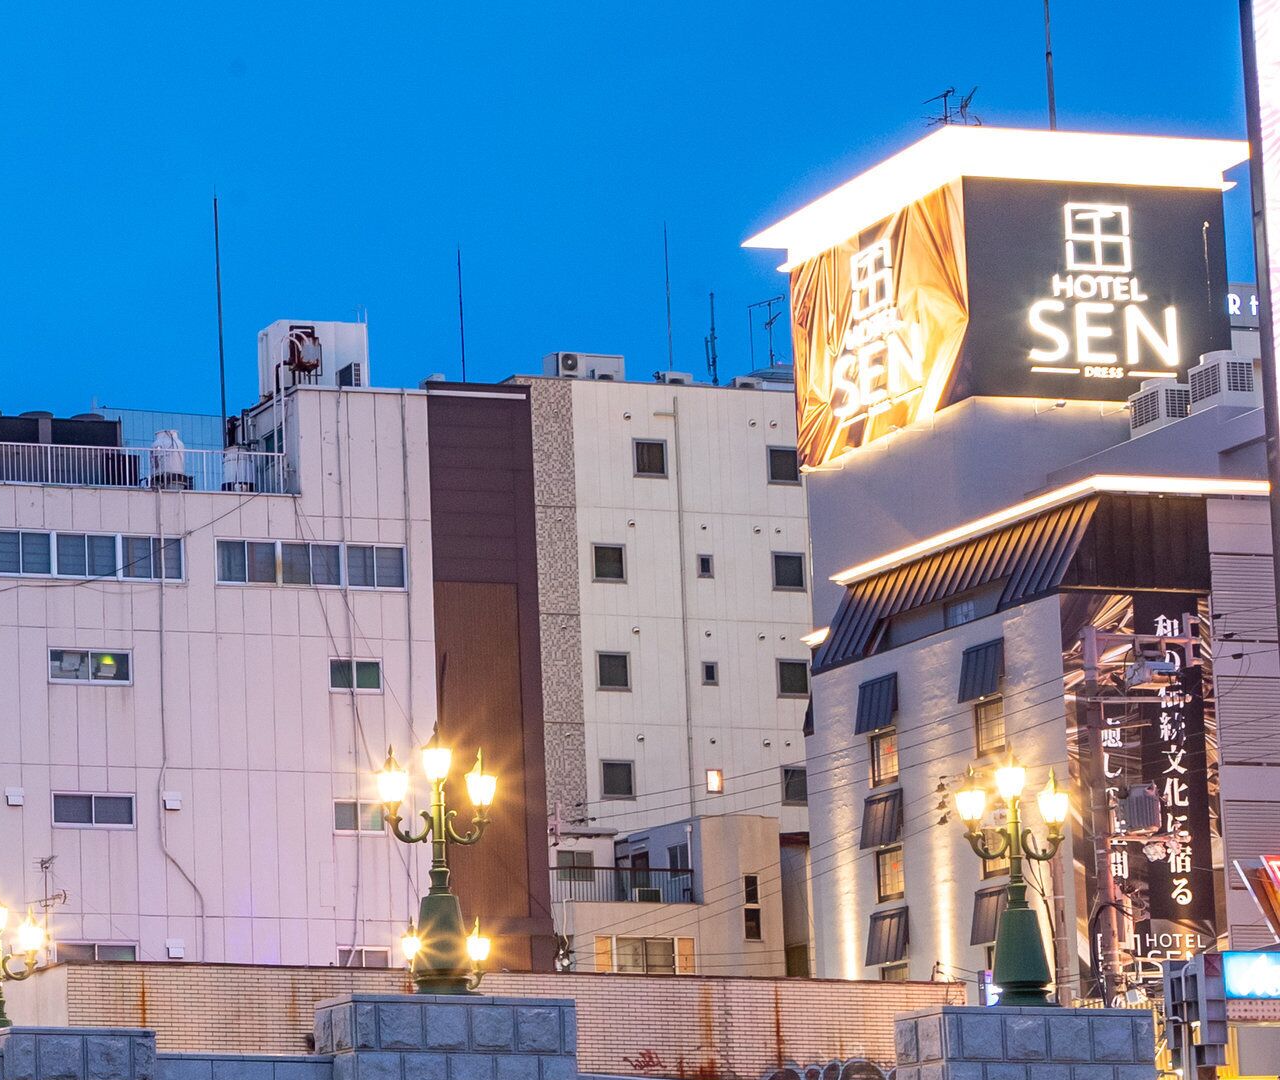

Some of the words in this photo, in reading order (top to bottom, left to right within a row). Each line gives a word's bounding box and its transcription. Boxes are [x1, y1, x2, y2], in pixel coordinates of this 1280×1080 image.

[1052, 273, 1148, 301] HOTEL
[1028, 300, 1180, 366] SEN
[832, 321, 924, 418] SEN
[1084, 366, 1124, 378] DRESS
[1146, 933, 1206, 949] HOTEL
